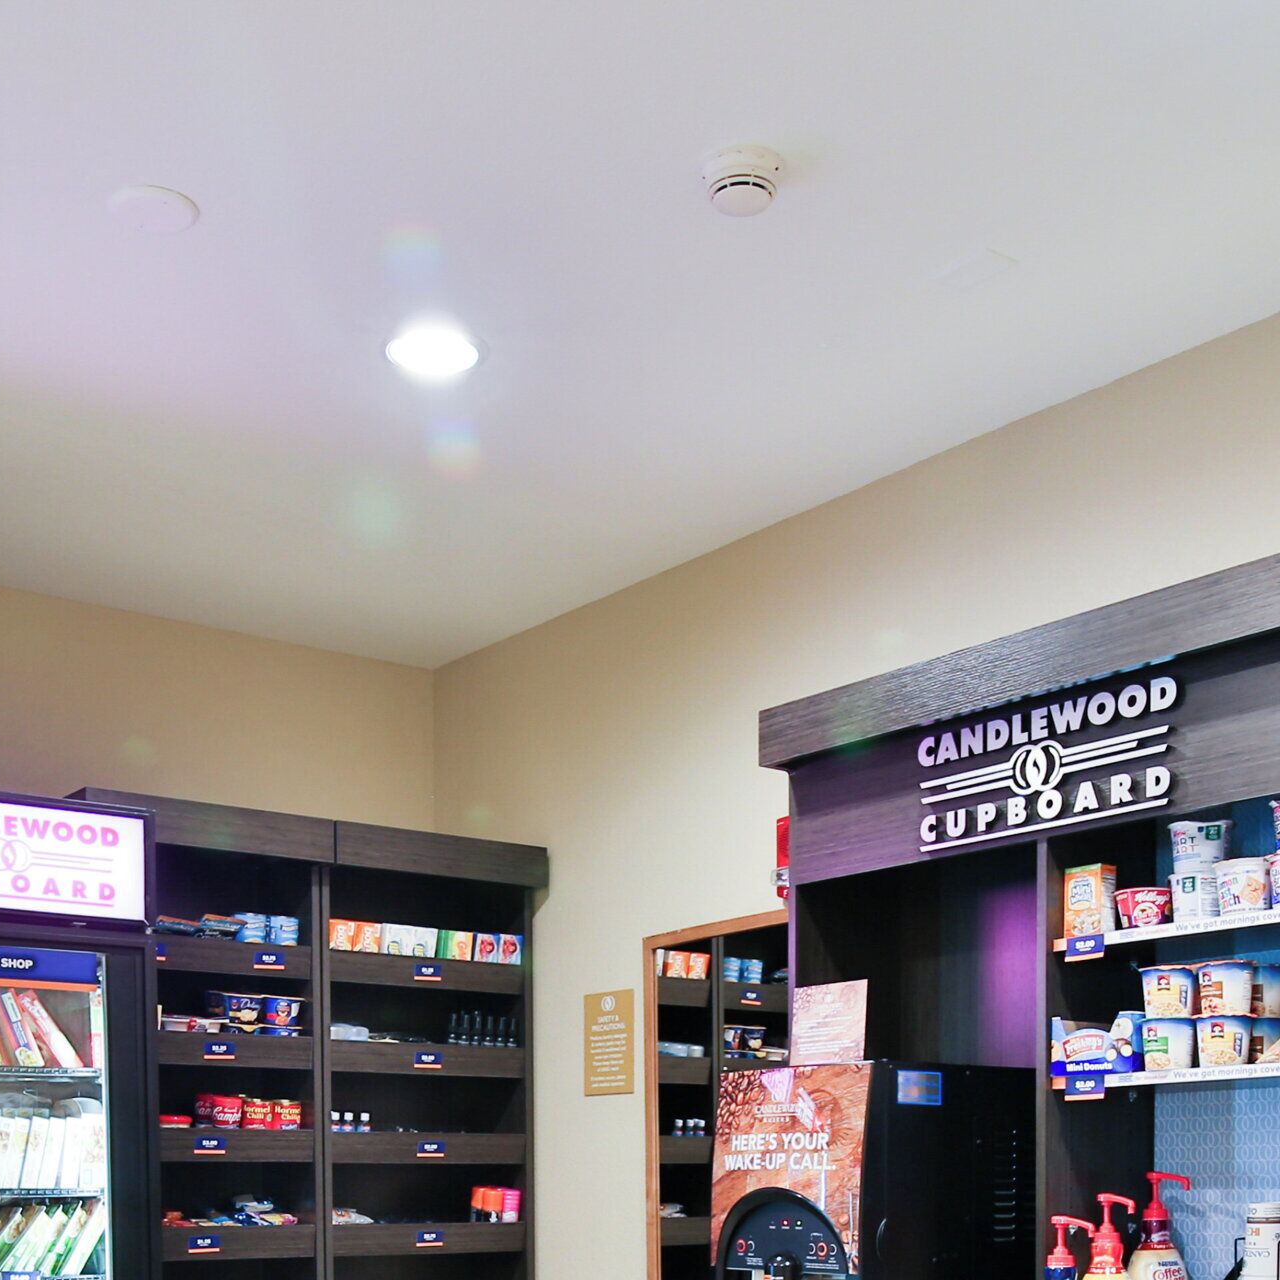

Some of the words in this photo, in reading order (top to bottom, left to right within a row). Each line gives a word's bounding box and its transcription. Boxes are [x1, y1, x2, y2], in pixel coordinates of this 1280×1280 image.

[918, 676, 1178, 768] CANDLEWOOD
[920, 766, 1170, 844] CUPBOARD
[1175, 920, 1202, 932] We've
[1202, 920, 1218, 931] got
[1220, 914, 1260, 928] mornings
[0, 956, 34, 970] SHOP
[1066, 1062, 1083, 1072] Mini
[1084, 1062, 1113, 1071] Donuts
[1172, 1070, 1199, 1080] We've
[1200, 1070, 1216, 1080] got
[1217, 1066, 1258, 1078] mornings
[244, 1106, 271, 1114] ormel
[246, 1112, 264, 1120] Chili
[732, 1133, 778, 1152] HERE'S
[781, 1132, 830, 1150] YOUR
[724, 1152, 786, 1171] WAKE-UP
[790, 1152, 837, 1170] CALL.
